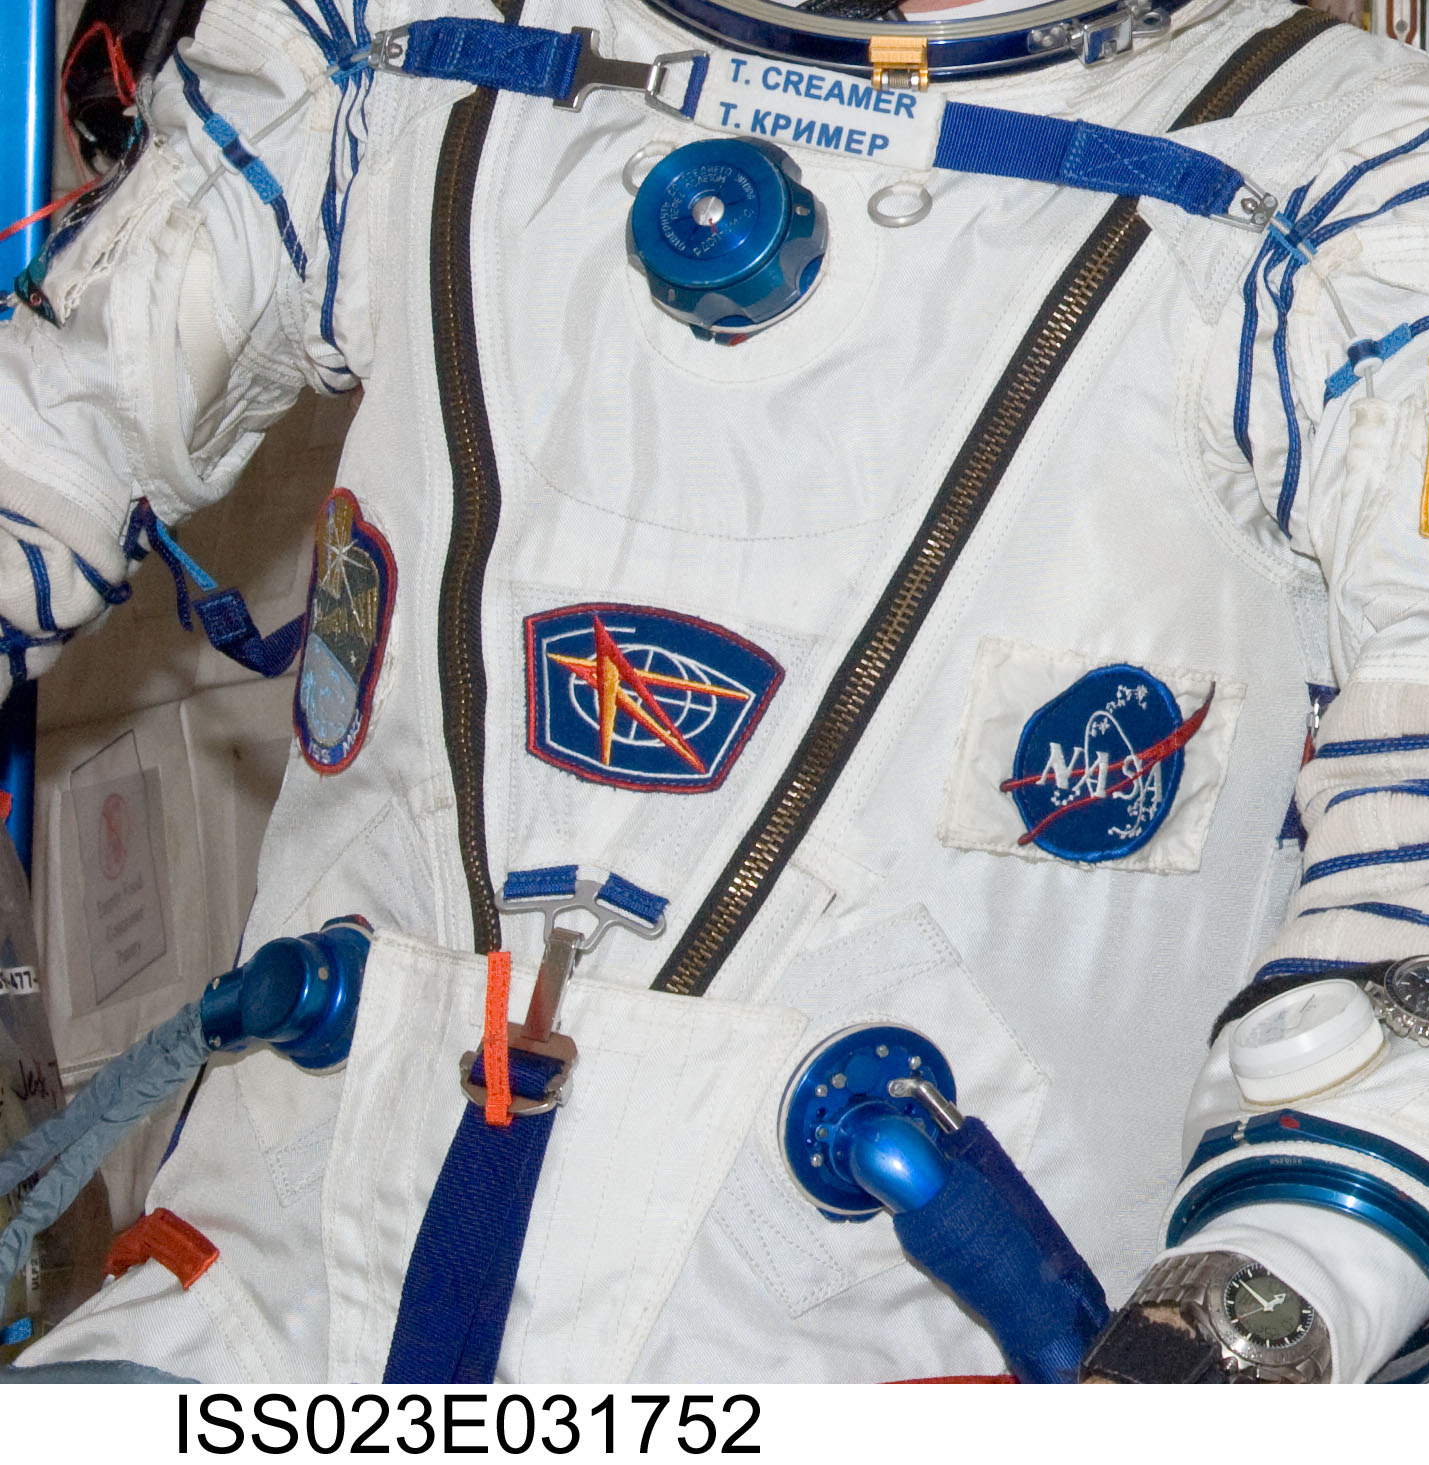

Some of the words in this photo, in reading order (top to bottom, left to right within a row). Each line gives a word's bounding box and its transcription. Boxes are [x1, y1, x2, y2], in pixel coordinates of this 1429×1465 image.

[731, 59, 758, 85] T.
[761, 66, 917, 119] CREAMER
[751, 109, 889, 157] КРИМЕР
[308, 739, 331, 765] ISS
[1035, 742, 1163, 804] NASA
